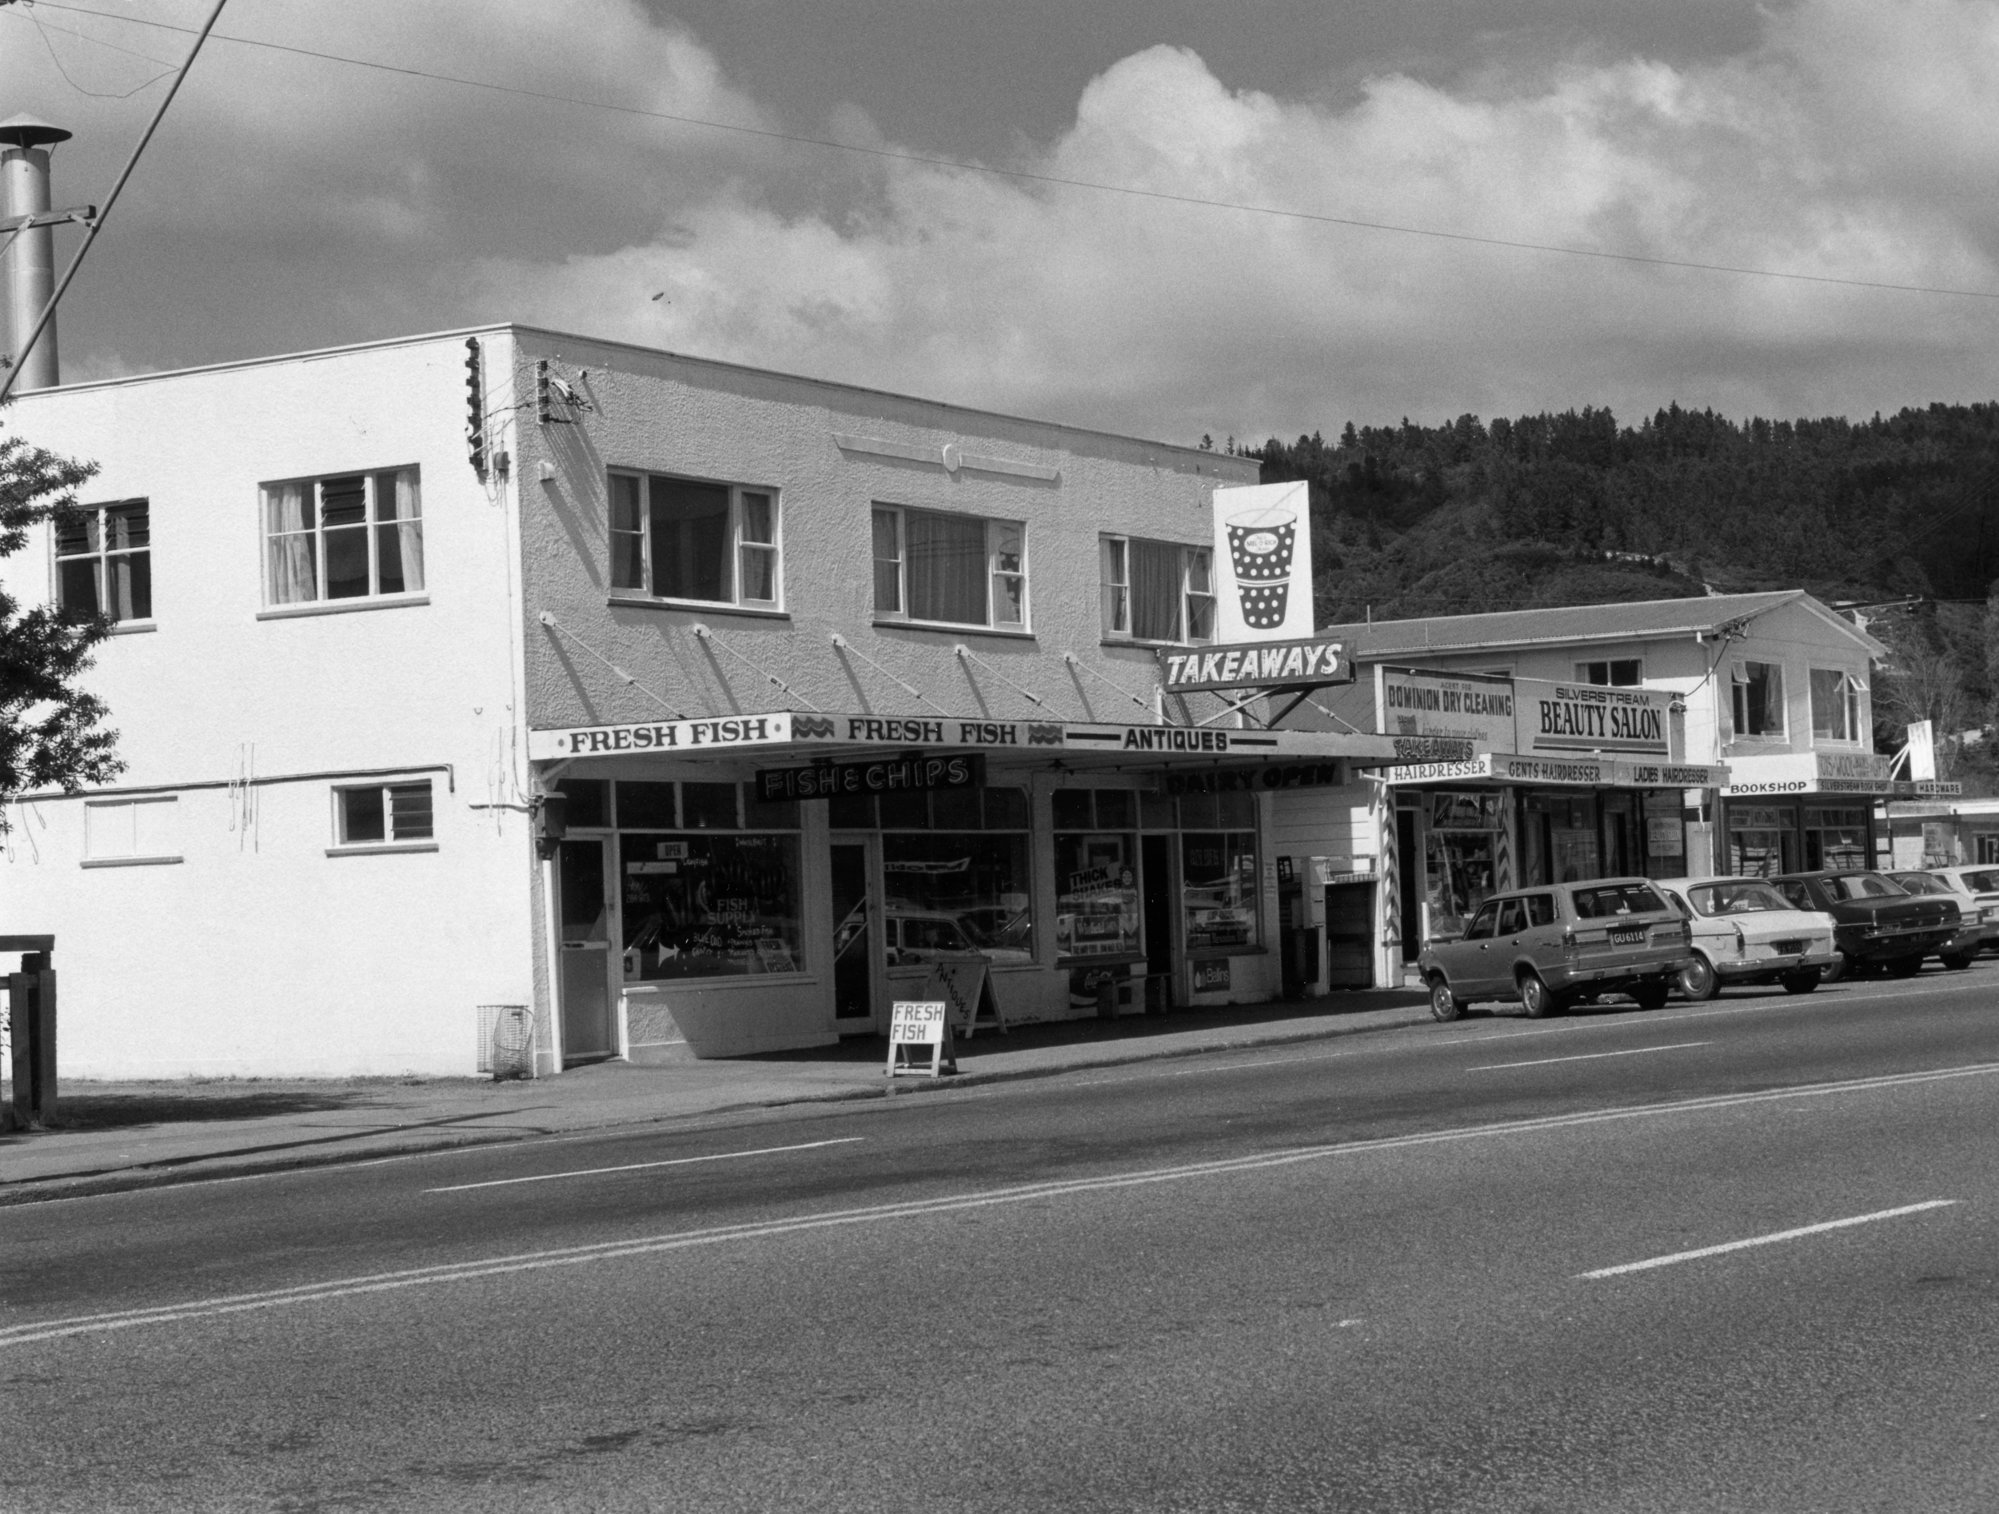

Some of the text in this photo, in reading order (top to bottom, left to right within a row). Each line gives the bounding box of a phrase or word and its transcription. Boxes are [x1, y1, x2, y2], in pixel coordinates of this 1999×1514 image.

[1167, 643, 1342, 685] TAKEAWAYS
[1388, 685, 1512, 716] DOMINION DRY CLEANING
[1556, 688, 1649, 706] SILVERSTREAM
[1539, 700, 1661, 739] BEAUTY SALON
[570, 718, 768, 753] FRESH FISH
[848, 719, 1017, 744] FRESH FISH
[1123, 729, 1228, 751] ANTIQUES
[1393, 738, 1474, 759] TAKEAWAYS
[765, 767, 839, 797] FISH
[866, 758, 969, 789] CHIPS
[1167, 763, 1336, 794] DAIRY OPEN
[1395, 760, 1486, 781] HAIRDRESSER
[1508, 761, 1601, 782] GENTS HAIRDRESSER
[1634, 766, 1708, 784] LADIES HAIRDRESSER
[1730, 782, 1807, 794] BOOKSHOP
[1071, 867, 1108, 887] THICK
[717, 898, 748, 911] FISH
[707, 910, 756, 925] SUPPLY
[894, 1004, 943, 1022] FRESH
[892, 1024, 926, 1041] FISH
